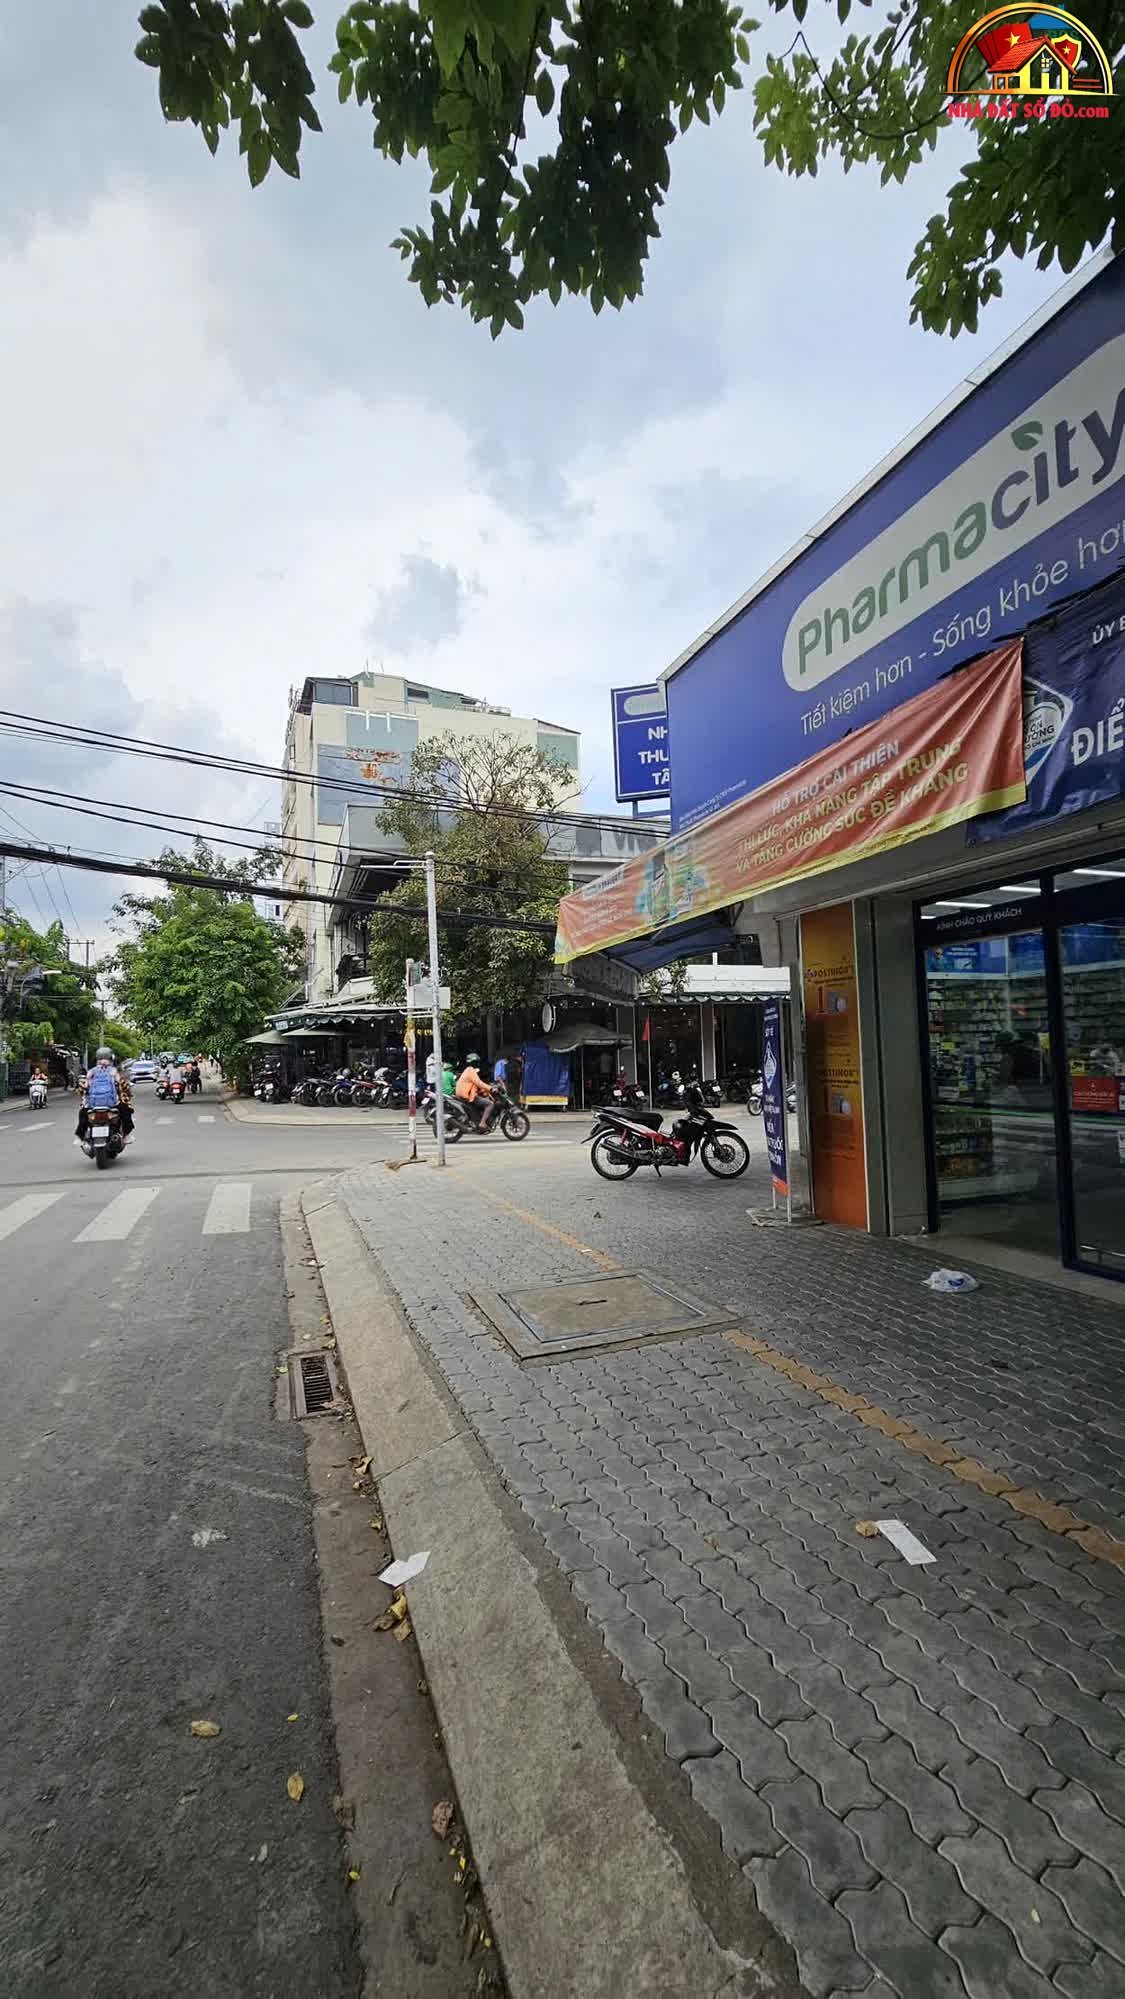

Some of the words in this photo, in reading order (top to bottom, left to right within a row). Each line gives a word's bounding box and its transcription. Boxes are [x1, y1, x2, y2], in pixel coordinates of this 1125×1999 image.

[799, 388, 1125, 674] Pharmacity
[801, 701, 827, 735] Tiết
[830, 680, 870, 715] kiệm
[875, 654, 912, 695] hơn
[932, 606, 991, 656] Sống
[1000, 560, 1068, 617] khỏe
[1078, 520, 1125, 570] hơ
[850, 741, 900, 775] THIỆN
